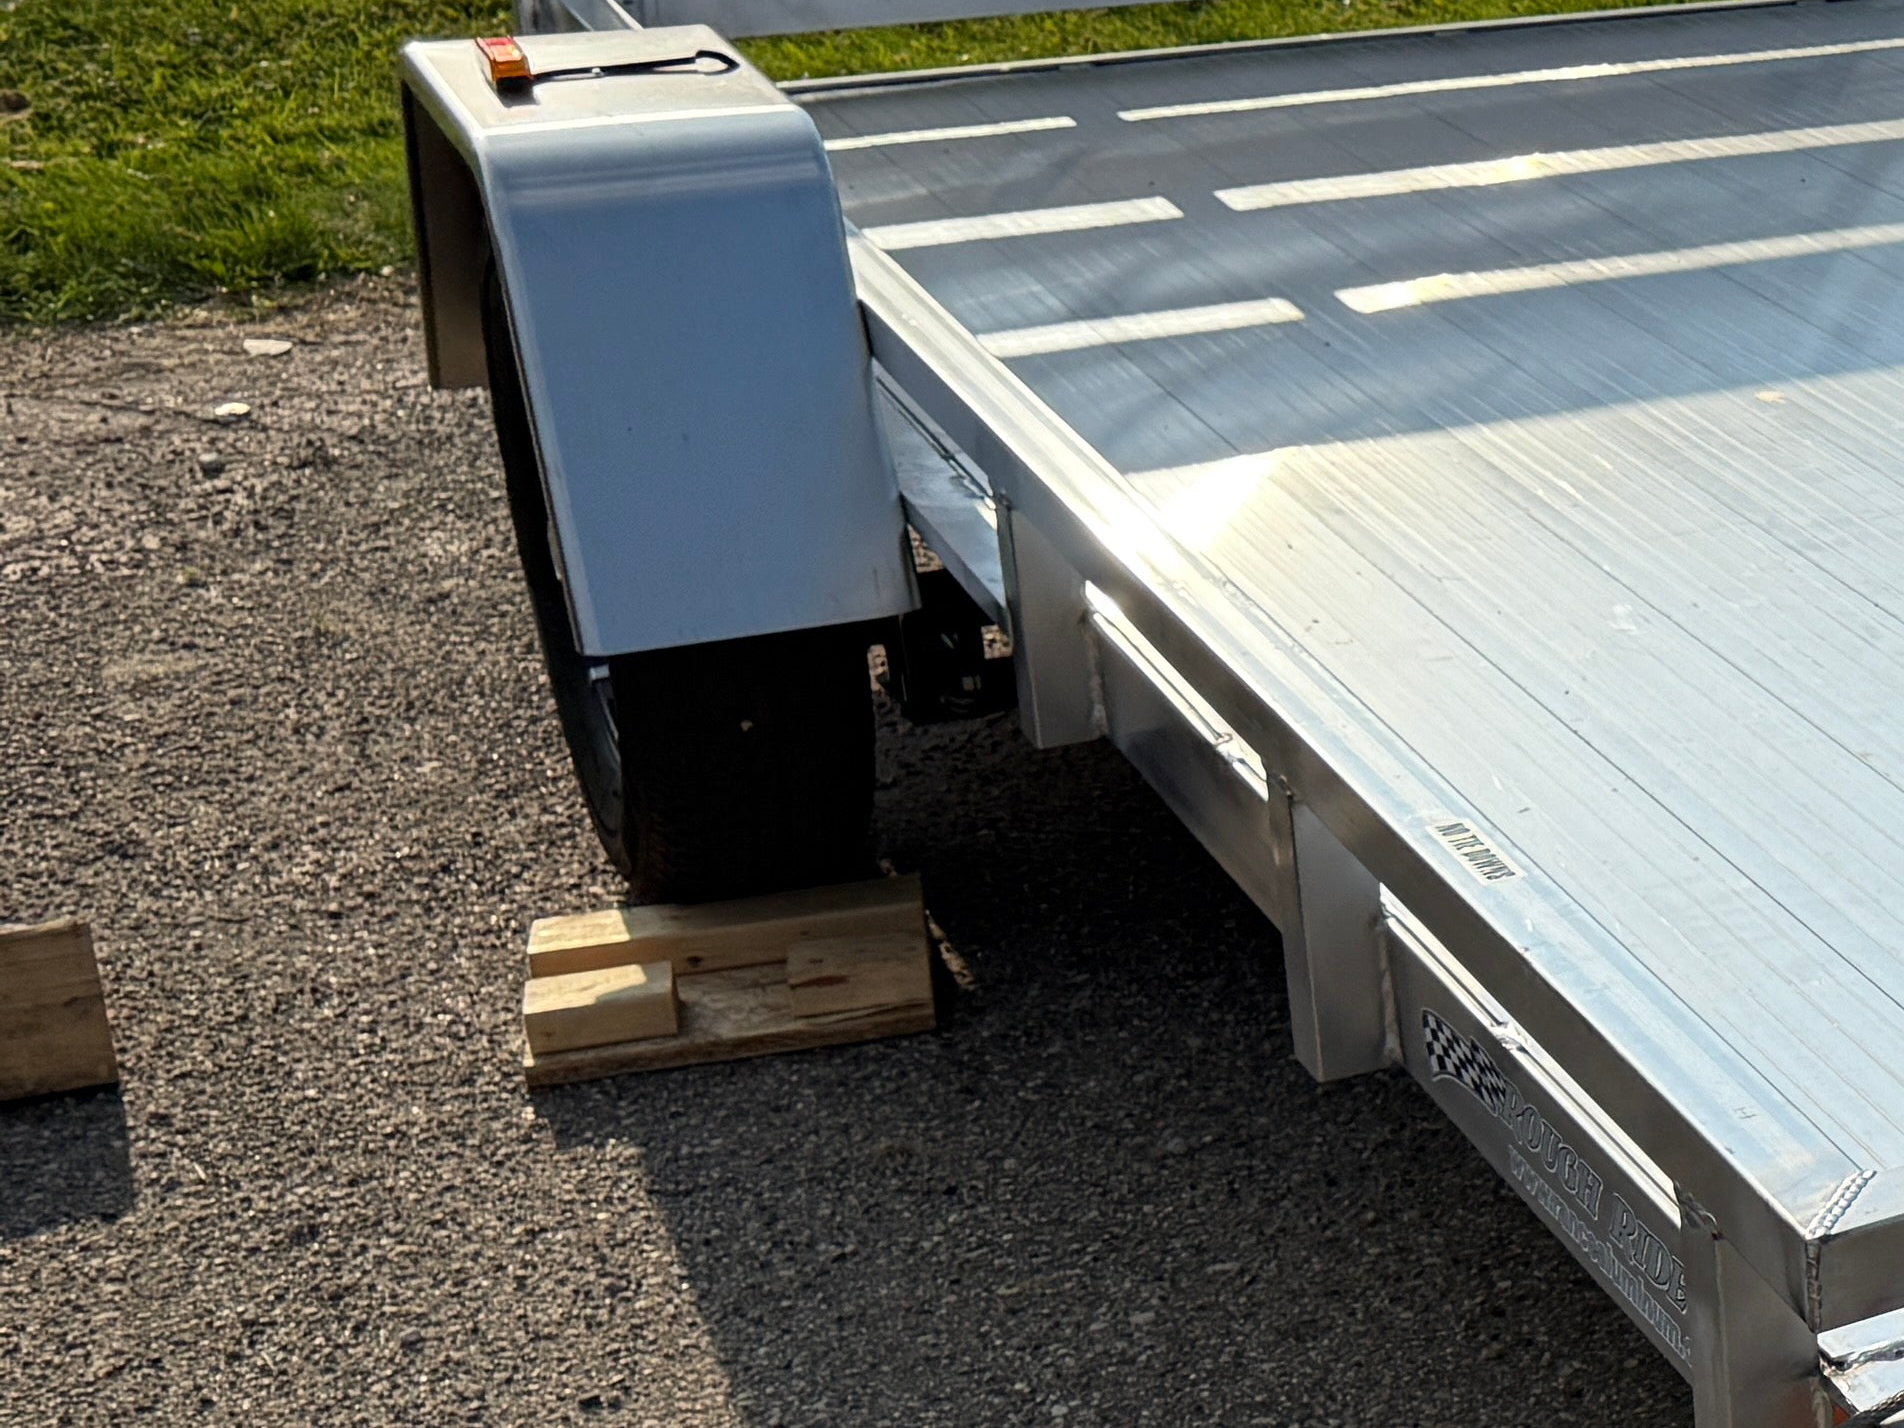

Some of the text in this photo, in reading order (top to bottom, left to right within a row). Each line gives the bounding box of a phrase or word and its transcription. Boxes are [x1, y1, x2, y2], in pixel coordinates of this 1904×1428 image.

[1435, 822, 1516, 881] NO TIE DOWNS
[1500, 1079, 1604, 1222] ROUGH
